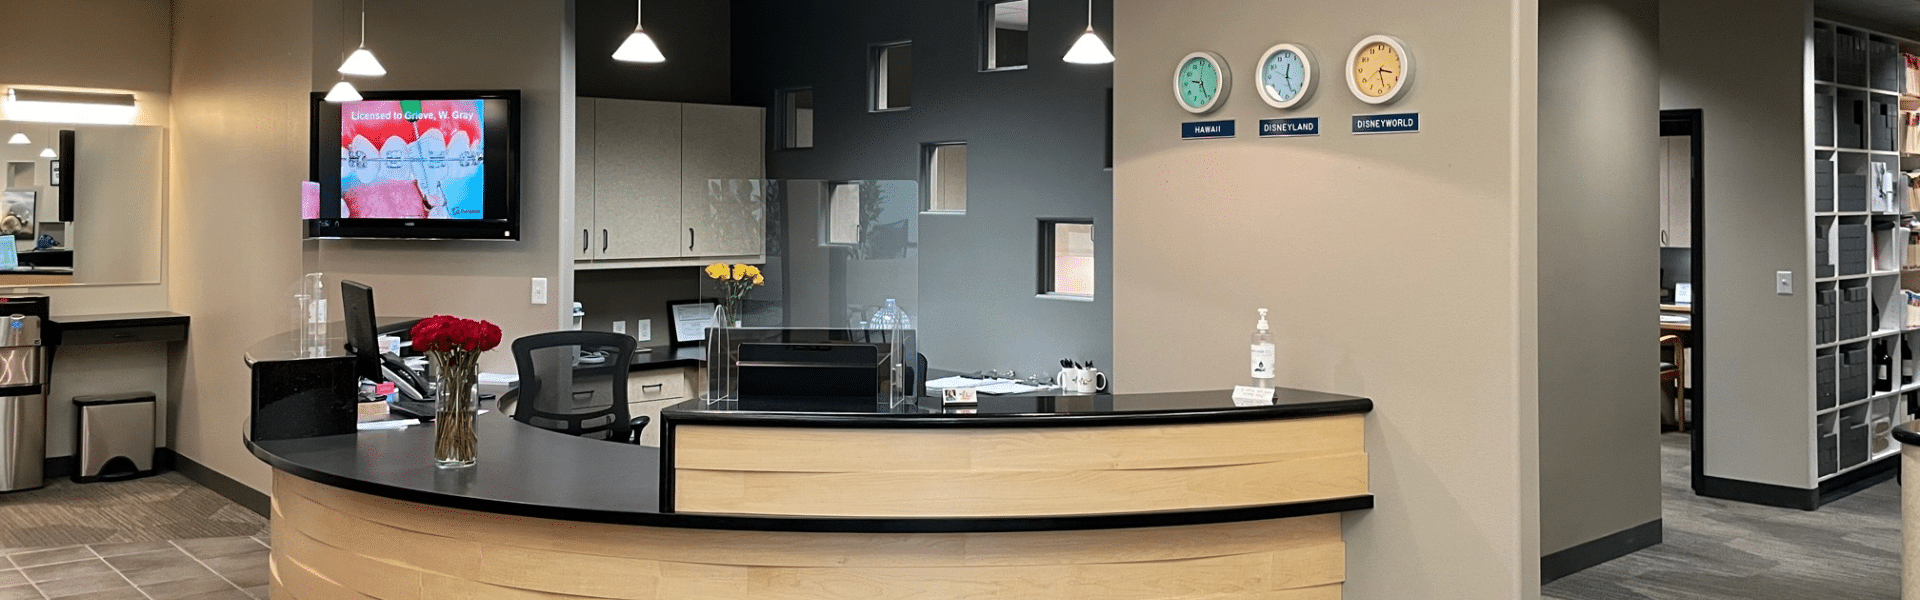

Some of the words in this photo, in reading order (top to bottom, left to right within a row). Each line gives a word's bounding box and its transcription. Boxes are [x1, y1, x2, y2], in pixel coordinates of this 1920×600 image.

[351, 111, 392, 120] Licensed
[393, 111, 403, 120] to
[404, 110, 437, 121] Grieve,
[438, 110, 449, 120] W.
[452, 110, 474, 121] Gray
[1263, 122, 1314, 132] DISNEYLAND
[1357, 118, 1414, 129] DISNEYWORLD
[1194, 125, 1221, 133] HAWAII
